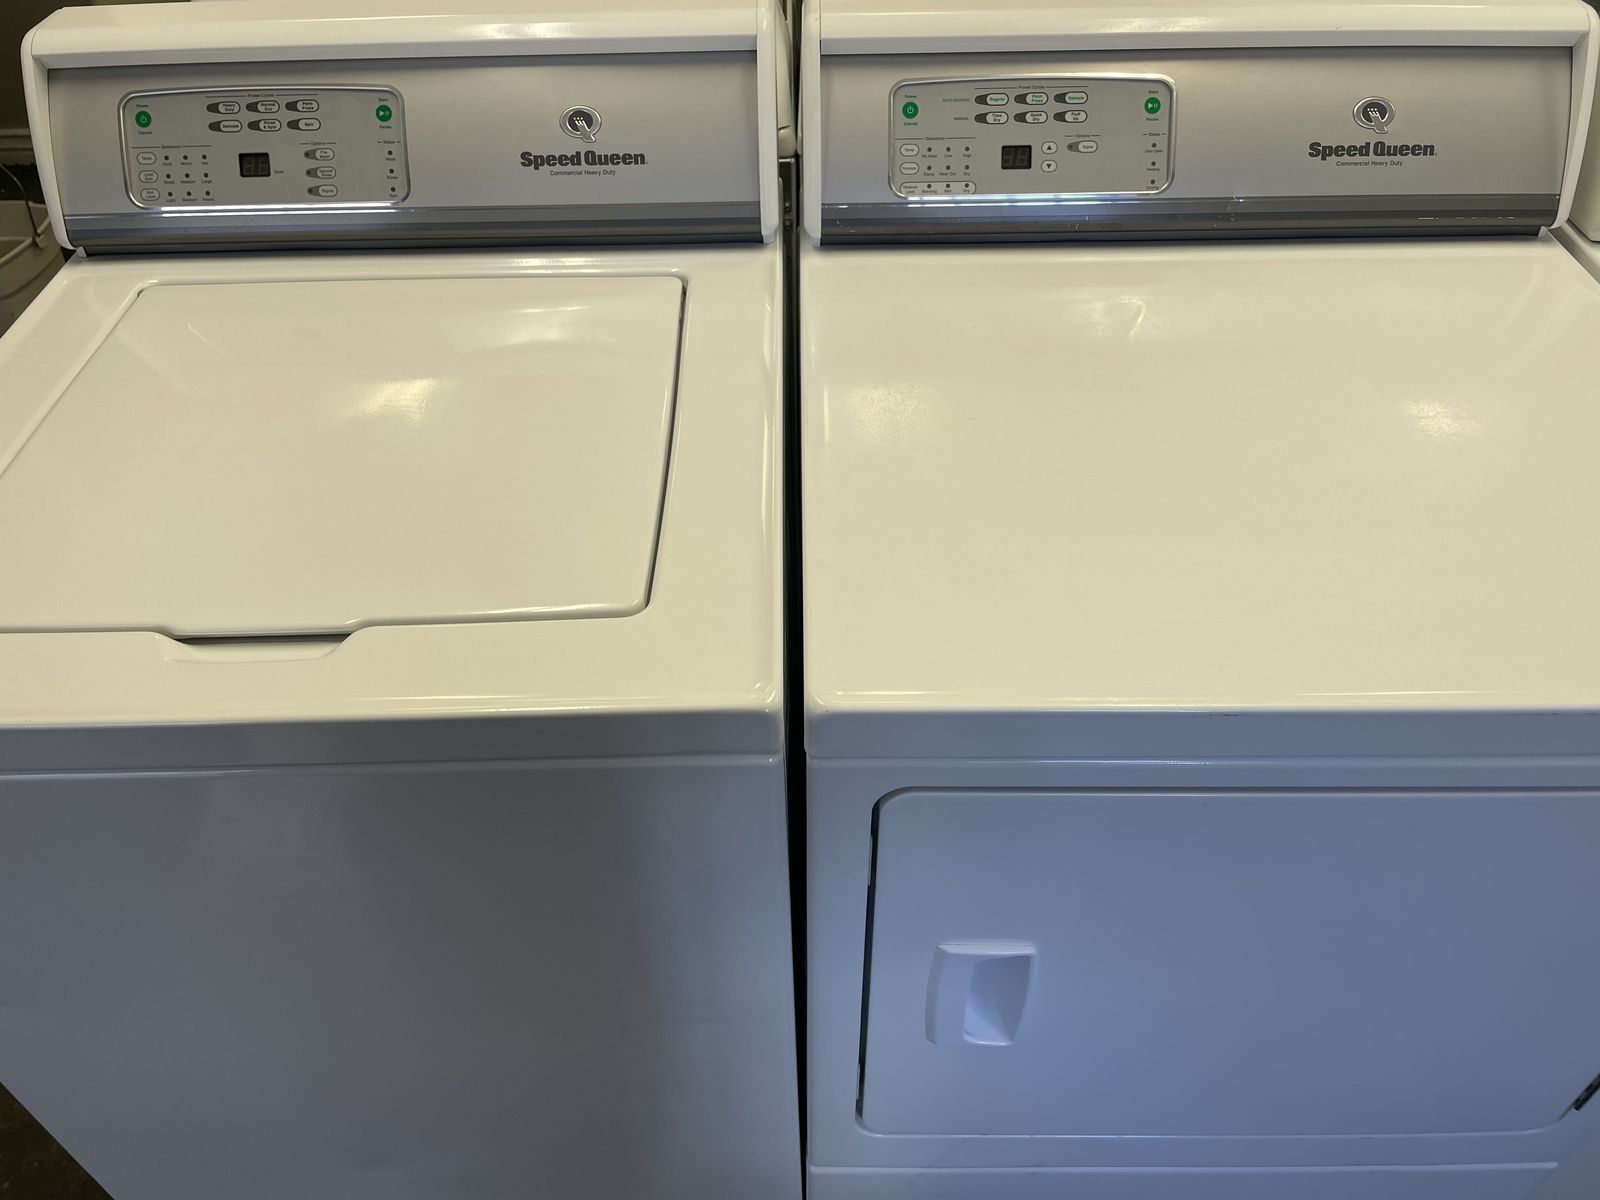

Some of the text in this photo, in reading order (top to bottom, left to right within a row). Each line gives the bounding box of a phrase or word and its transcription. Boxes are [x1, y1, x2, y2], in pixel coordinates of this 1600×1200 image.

[520, 150, 645, 170] Speed Queen
[1308, 141, 1435, 161] Speed Queen
